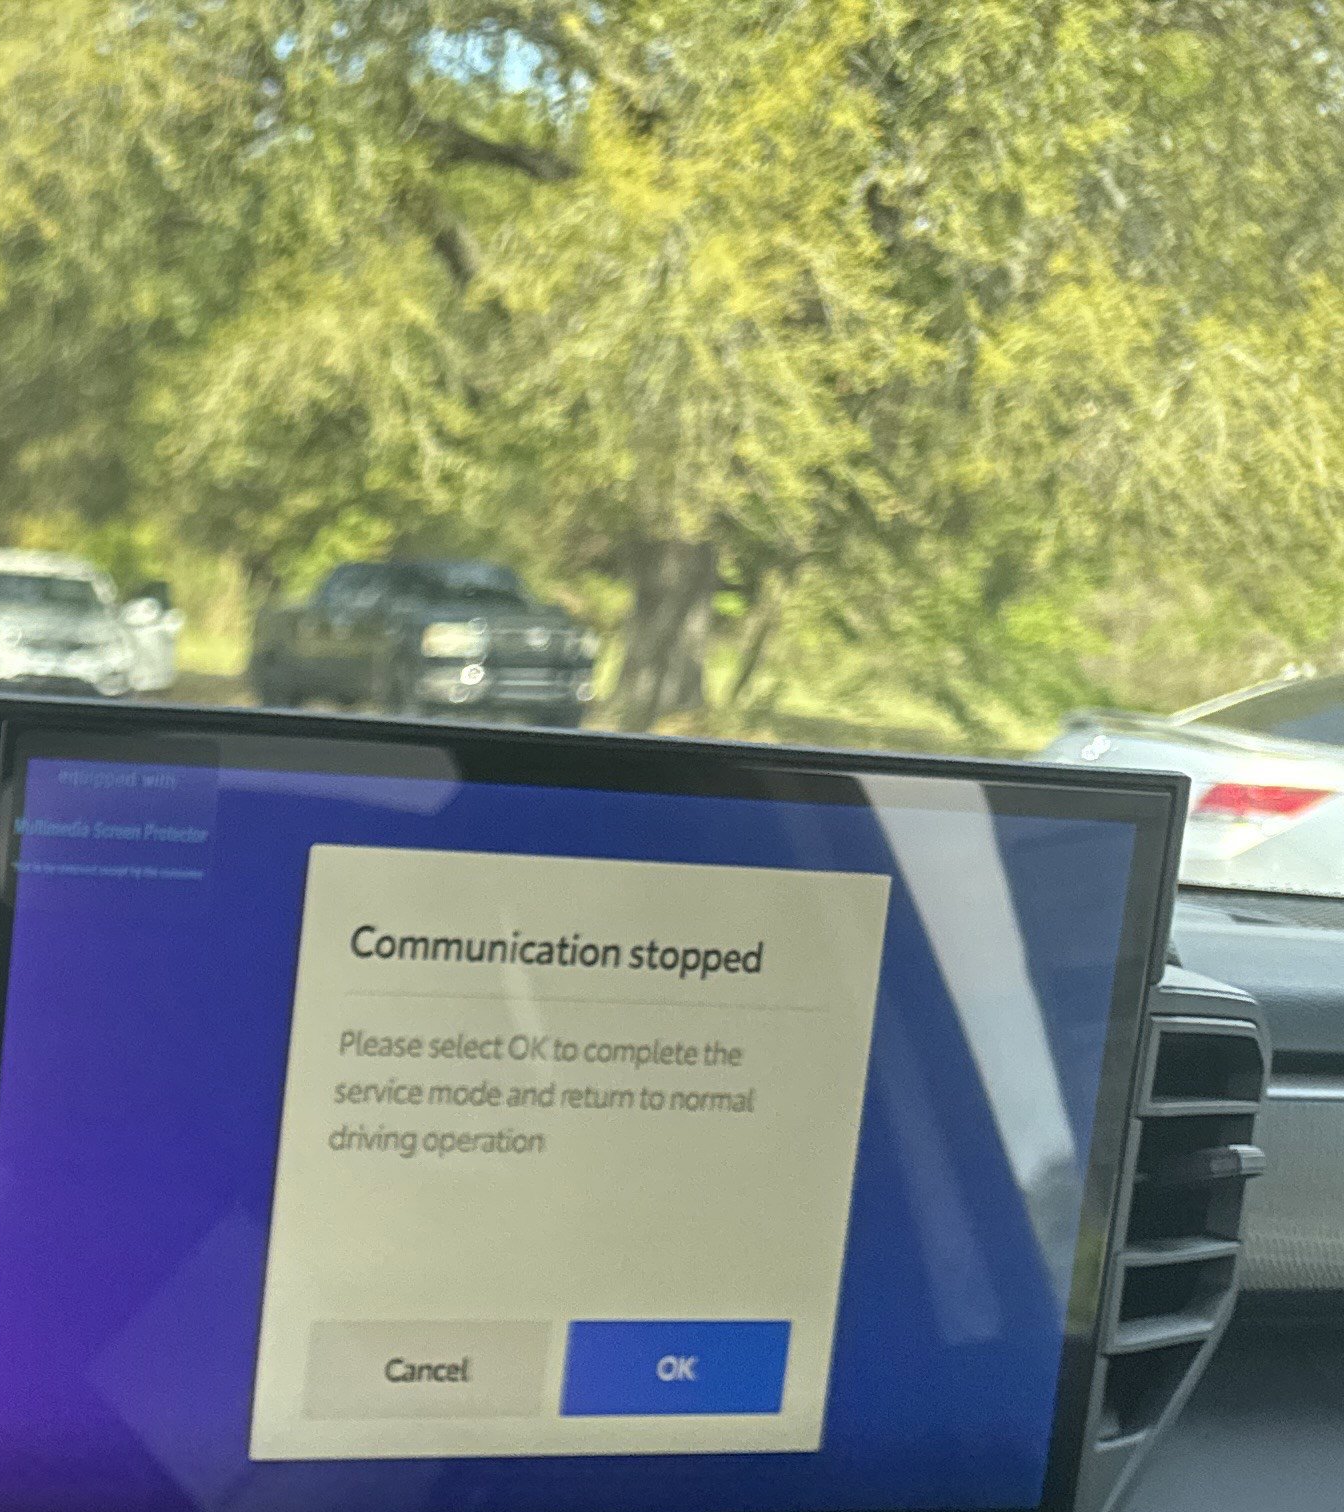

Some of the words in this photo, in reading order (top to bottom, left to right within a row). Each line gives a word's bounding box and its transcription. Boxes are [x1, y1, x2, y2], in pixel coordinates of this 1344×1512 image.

[350, 924, 621, 970] Communication
[628, 941, 765, 981] stopped
[339, 1030, 423, 1059] Please
[427, 1034, 503, 1062] select
[507, 1033, 552, 1062] OK
[552, 1038, 579, 1064] to
[583, 1038, 698, 1070] complete
[702, 1041, 744, 1067] the
[333, 1077, 423, 1106] service
[428, 1080, 502, 1108] mode
[506, 1082, 557, 1110] and
[559, 1084, 634, 1111] return
[638, 1085, 665, 1111] to
[669, 1086, 756, 1114] normal
[327, 1124, 418, 1159] driving
[421, 1127, 548, 1159] operation
[384, 1356, 473, 1383] Cancel
[656, 1355, 699, 1382] OK
